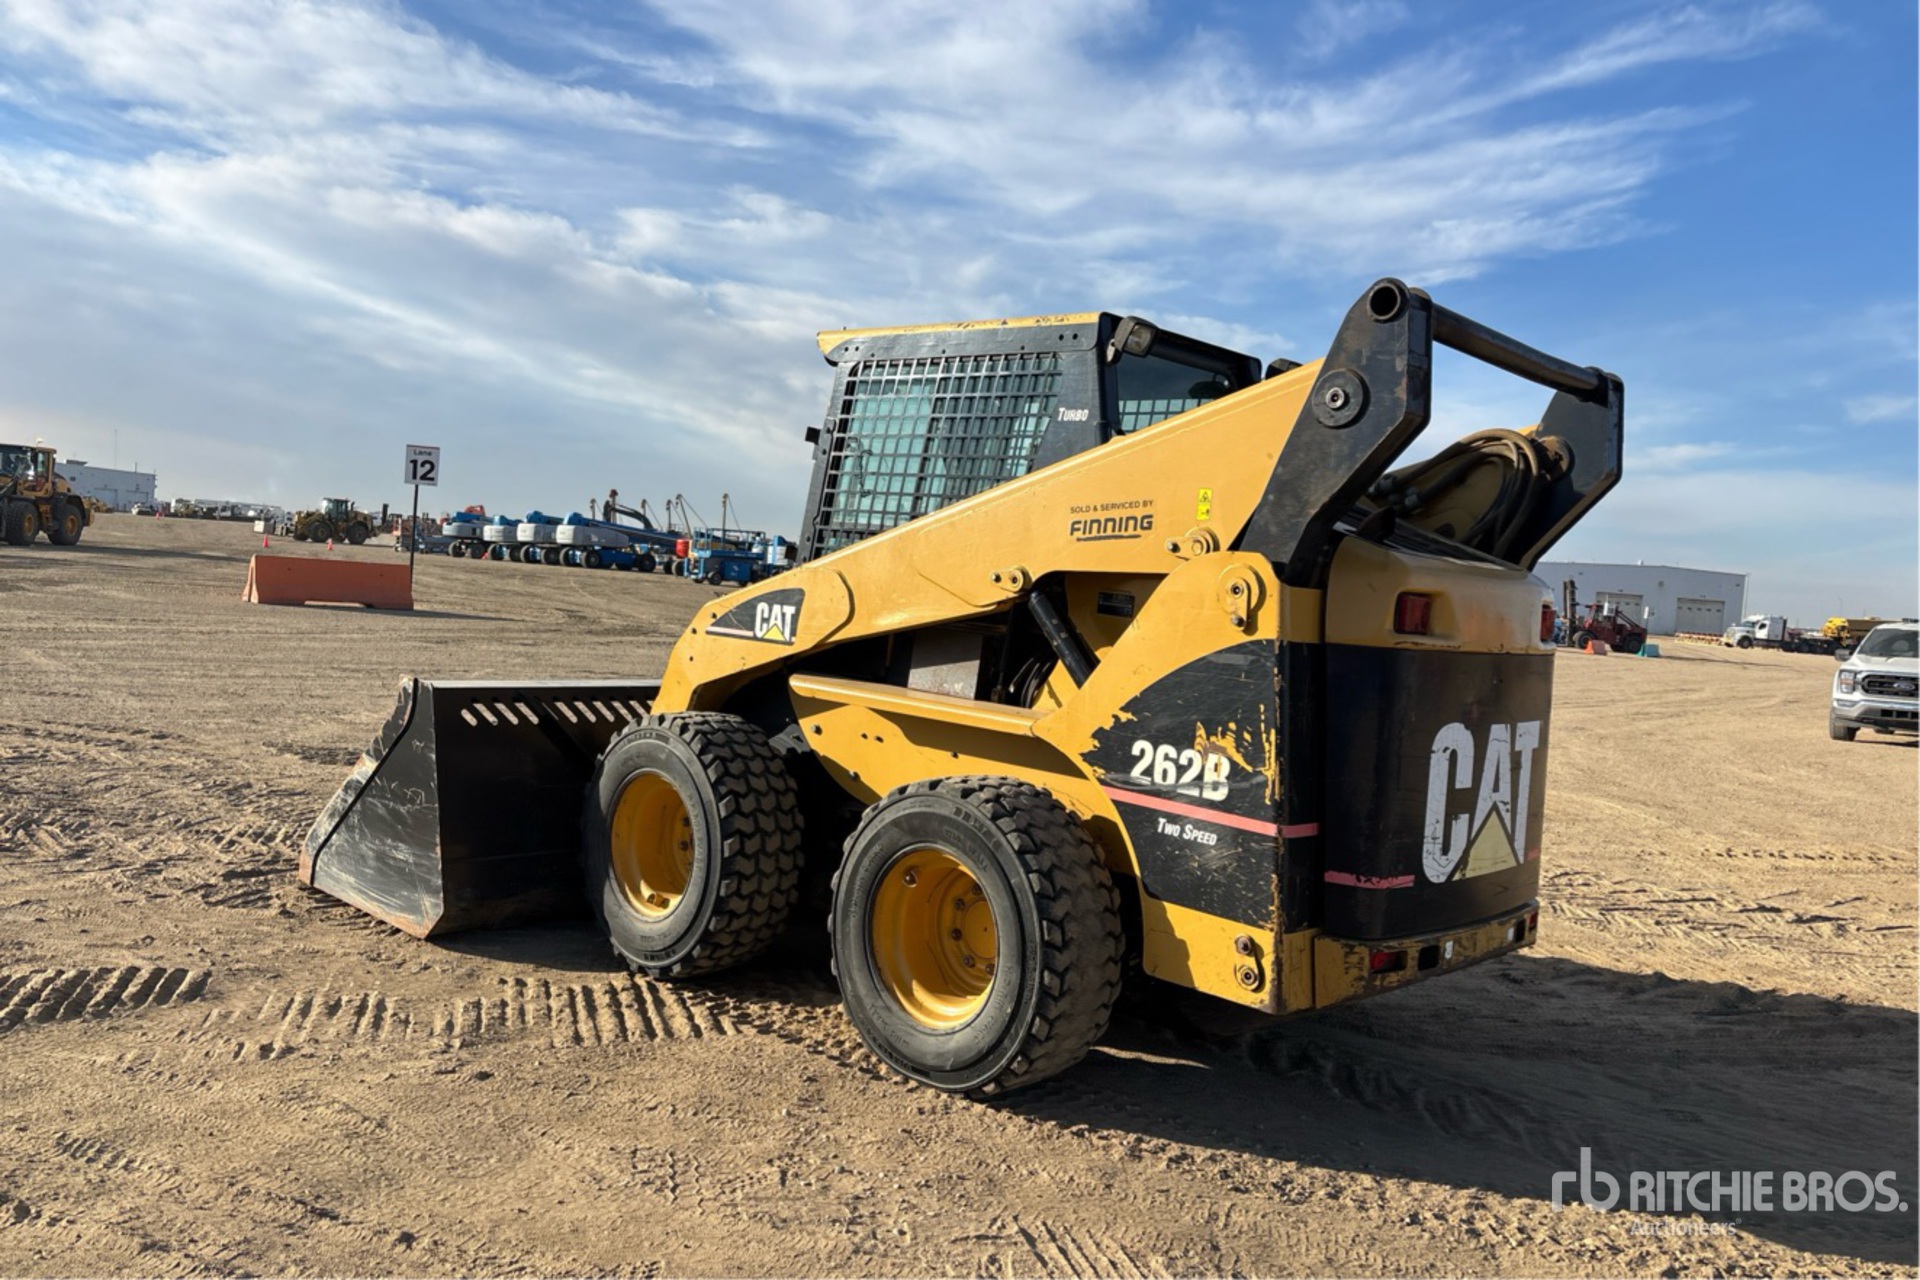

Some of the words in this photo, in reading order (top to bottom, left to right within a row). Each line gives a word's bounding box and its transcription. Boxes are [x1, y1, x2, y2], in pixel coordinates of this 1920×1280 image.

[409, 459, 435, 481] 12
[1070, 505, 1091, 514] SOLD
[1093, 504, 1098, 512] &
[1100, 500, 1140, 511] SERVICED
[1142, 499, 1154, 508] BY
[1070, 514, 1153, 536] FINNING
[755, 601, 796, 642] CAT
[1129, 739, 1231, 801] 262B
[1422, 720, 1541, 883] CAT
